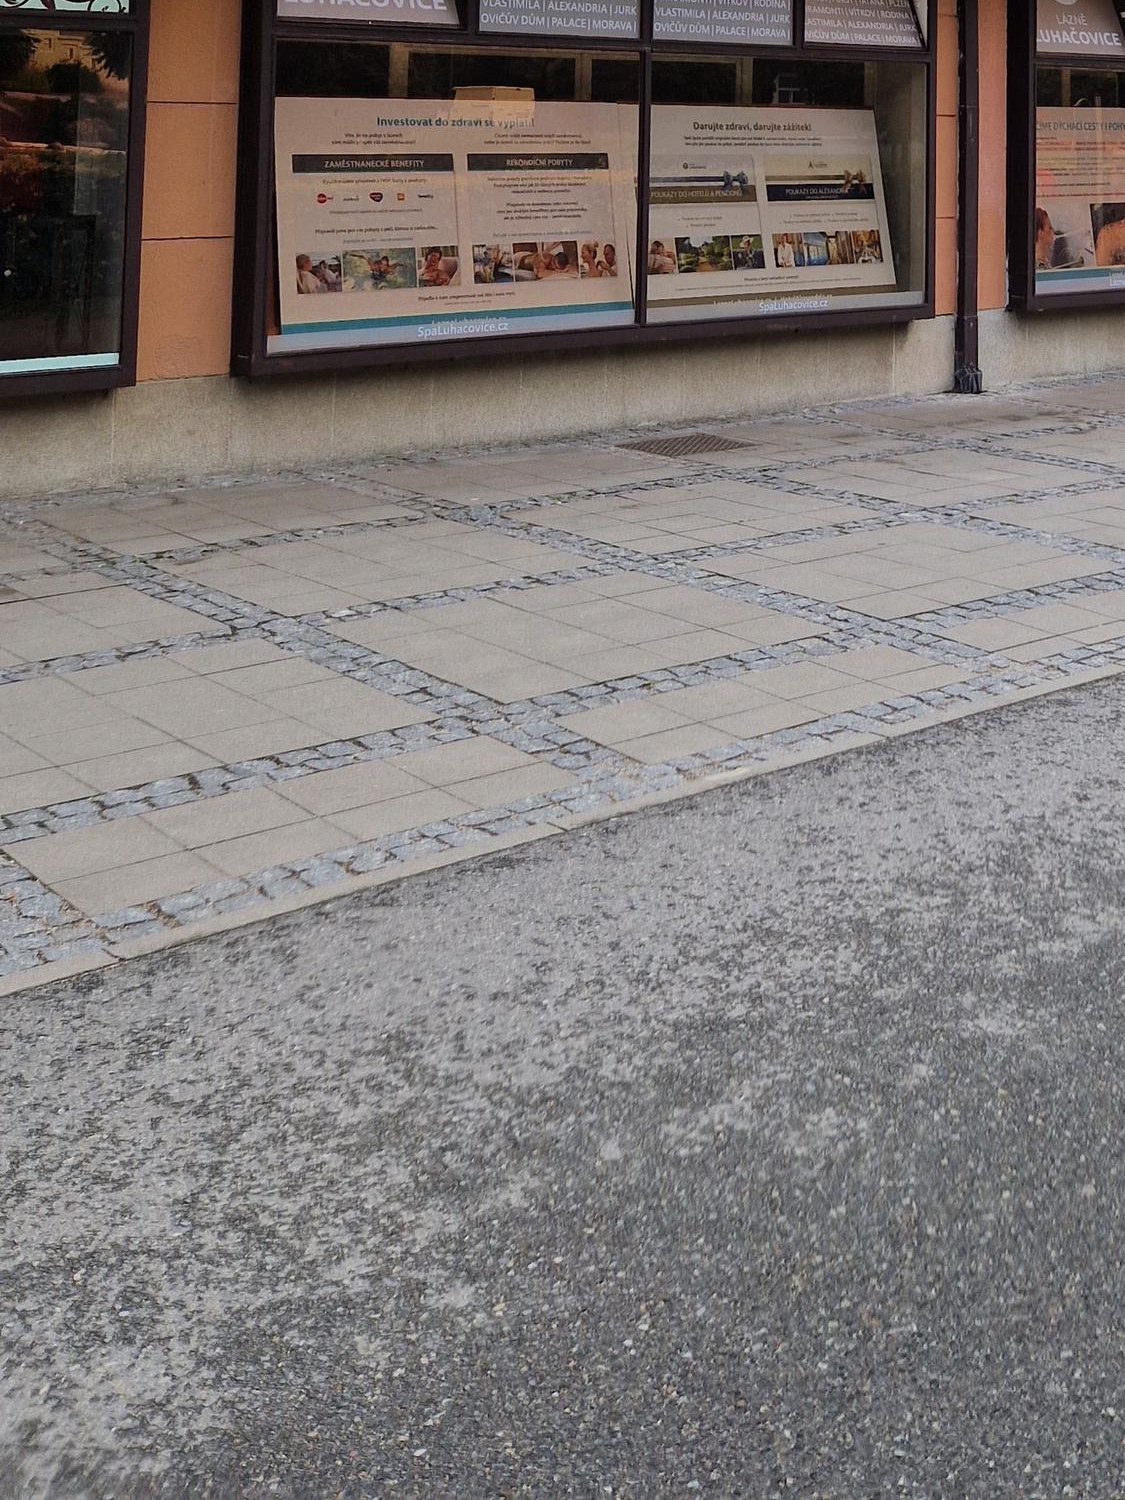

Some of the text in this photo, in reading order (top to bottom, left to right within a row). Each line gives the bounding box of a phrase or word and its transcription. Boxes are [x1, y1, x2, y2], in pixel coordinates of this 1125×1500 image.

[548, 1, 607, 14] ALEXANDRIA
[614, 6, 637, 15] JURK
[754, 0, 786, 8] RODINA
[655, 7, 790, 23] VLASTIMILA ALEXANDRIA JURK
[1056, 13, 1088, 26] LÁZNĚ
[521, 14, 545, 27] DŮM
[552, 18, 586, 28] PALACE
[592, 19, 632, 31] MORAVA
[689, 22, 710, 34] DŮM
[716, 25, 746, 36] PALACE
[752, 27, 786, 38] MORAVA
[377, 117, 432, 127] Investovat
[435, 118, 448, 127] do
[693, 121, 724, 132] Darujte
[753, 123, 781, 132] darujte
[759, 300, 828, 313] SpaLuhacovice.cz
[418, 322, 509, 339] SpaLuhacovice.cz
